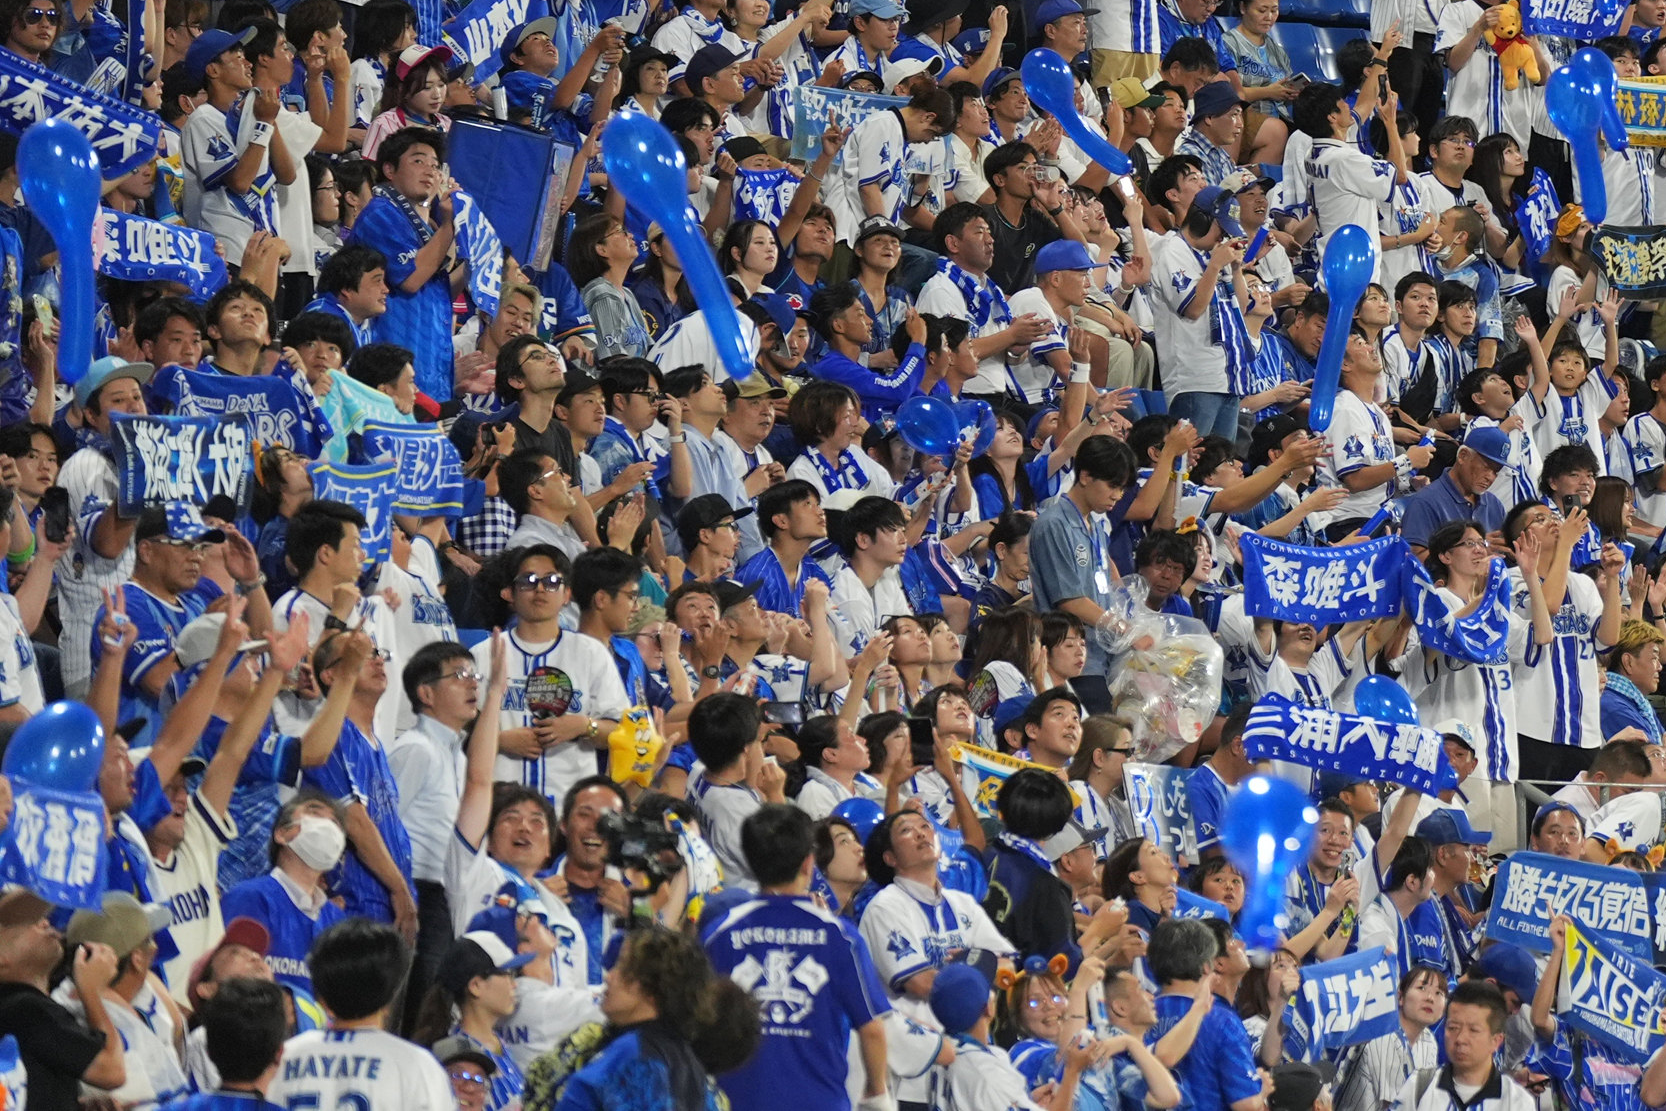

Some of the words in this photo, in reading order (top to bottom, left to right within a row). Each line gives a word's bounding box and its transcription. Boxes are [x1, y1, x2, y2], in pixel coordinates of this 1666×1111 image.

[228, 393, 270, 413] DeNA
[1262, 553, 1386, 610] 森唯斗
[1497, 669, 1512, 691] 3
[1242, 701, 1441, 776] 三浦大輔
[1360, 764, 1432, 788] MIURA
[730, 926, 829, 948] YOKOHAMA
[1611, 952, 1636, 978] IRIE
[283, 1055, 382, 1081] HAYATE
